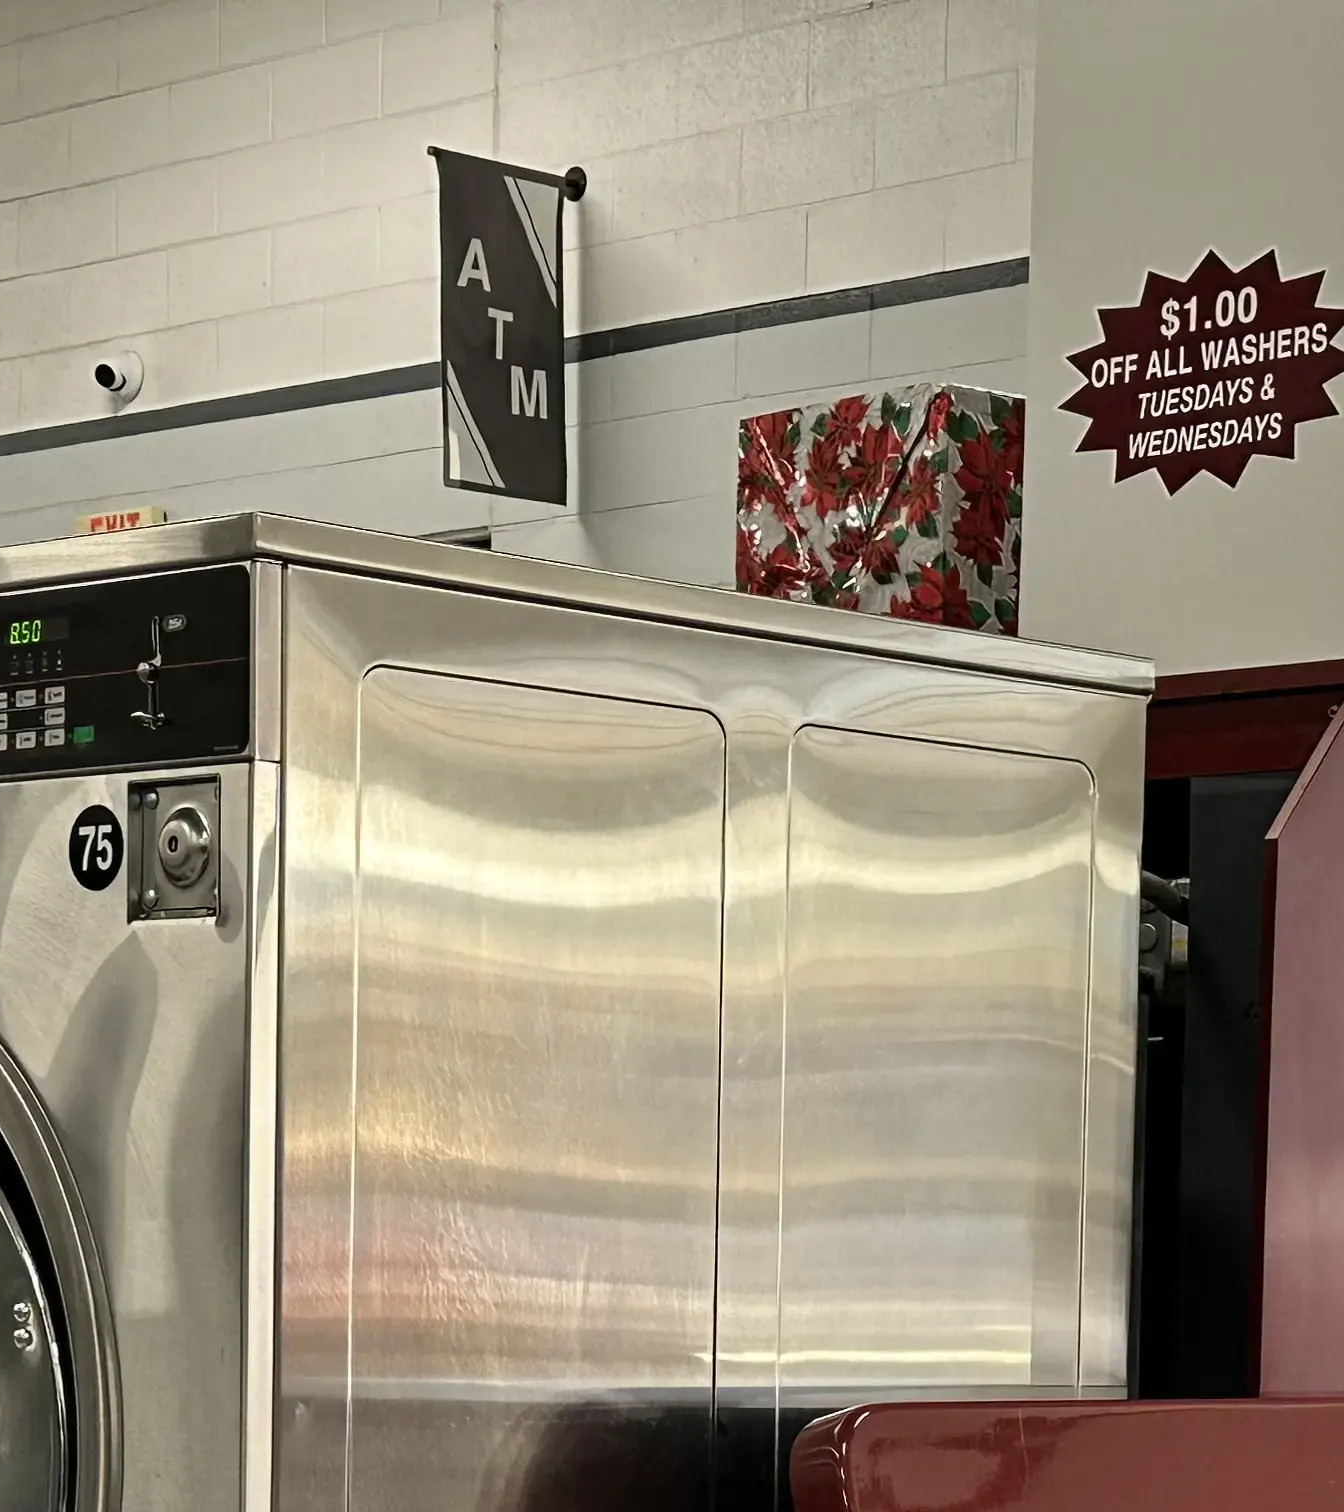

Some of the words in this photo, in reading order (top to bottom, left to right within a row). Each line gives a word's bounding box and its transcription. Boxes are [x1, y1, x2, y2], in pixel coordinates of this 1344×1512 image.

[457, 238, 548, 420] ATM
[1160, 286, 1258, 339] $1.00
[1090, 353, 1139, 389] OFF
[1145, 345, 1193, 381] ALL
[1201, 323, 1329, 370] WASHERS
[1138, 378, 1254, 421] TUESDAYS
[1260, 372, 1276, 401] &
[1128, 412, 1283, 460] WEDNESDAYS
[77, 824, 113, 871] 75
